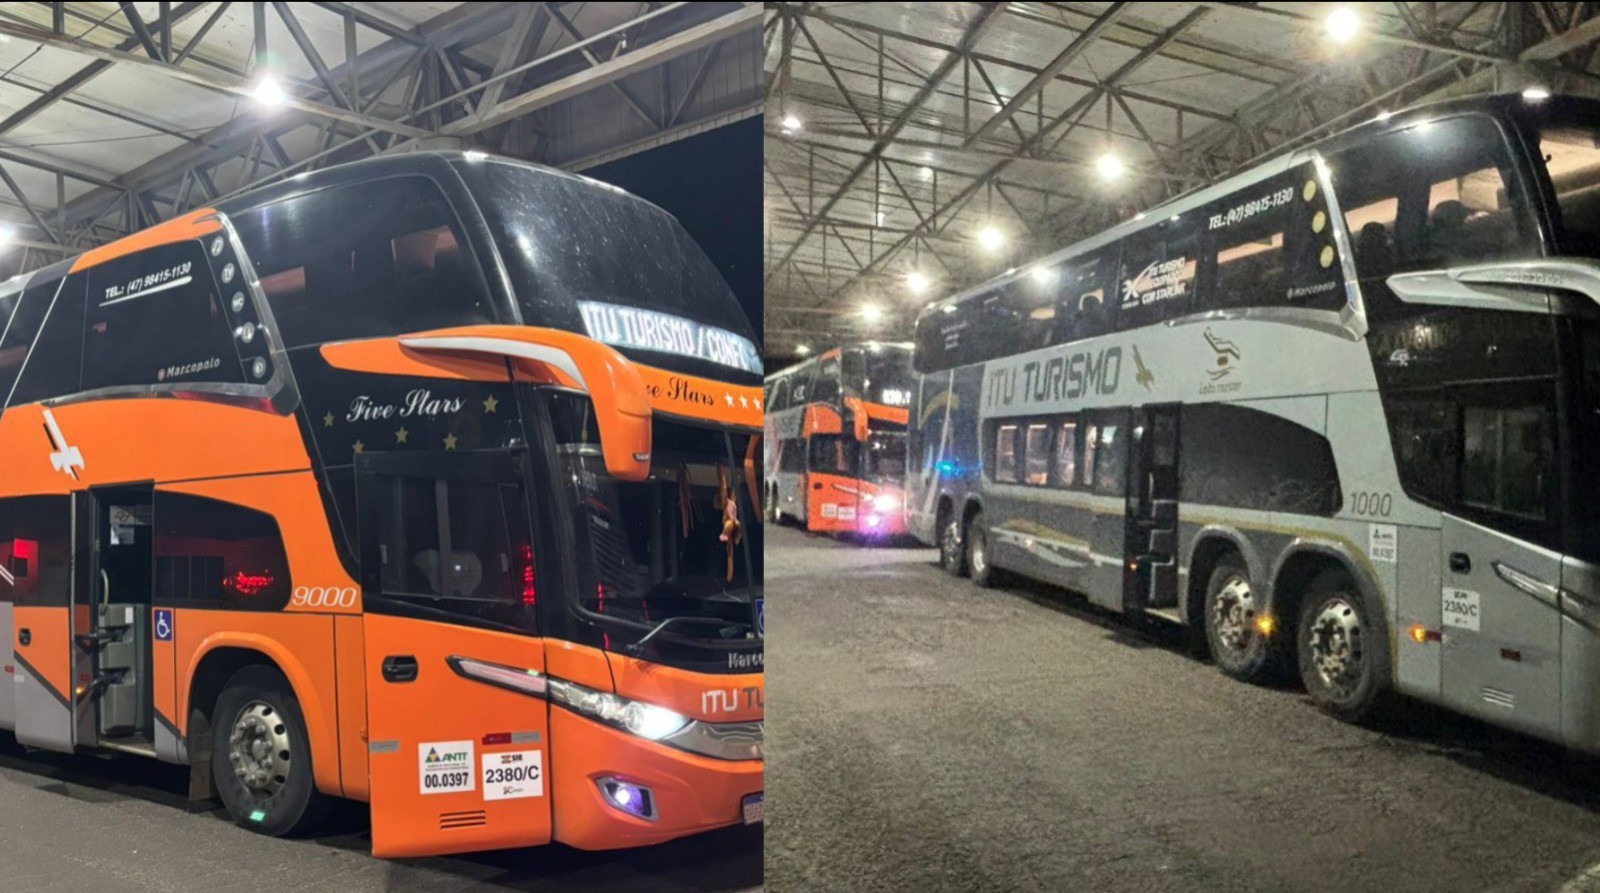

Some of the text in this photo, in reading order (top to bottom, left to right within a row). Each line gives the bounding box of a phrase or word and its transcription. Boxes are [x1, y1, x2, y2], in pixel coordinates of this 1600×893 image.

[1227, 206, 1244, 226] (47)
[1244, 186, 1294, 219] 98415-1130
[126, 278, 143, 295] (47)
[144, 261, 192, 288] 98415-1130
[583, 303, 618, 340] ITU
[618, 309, 696, 356] TURISMO
[166, 357, 221, 378] Marcopolo
[987, 345, 1122, 406] ITU TURISMO
[667, 377, 715, 407] Stars
[346, 388, 467, 422] Five Stars
[1350, 492, 1392, 517] 1000
[292, 586, 357, 608] 9000
[1445, 600, 1477, 617] 2380/C
[702, 688, 738, 714] ITU
[441, 752, 468, 762] ANTT
[424, 772, 469, 788] 00.0397
[485, 765, 539, 783] 2380/C
